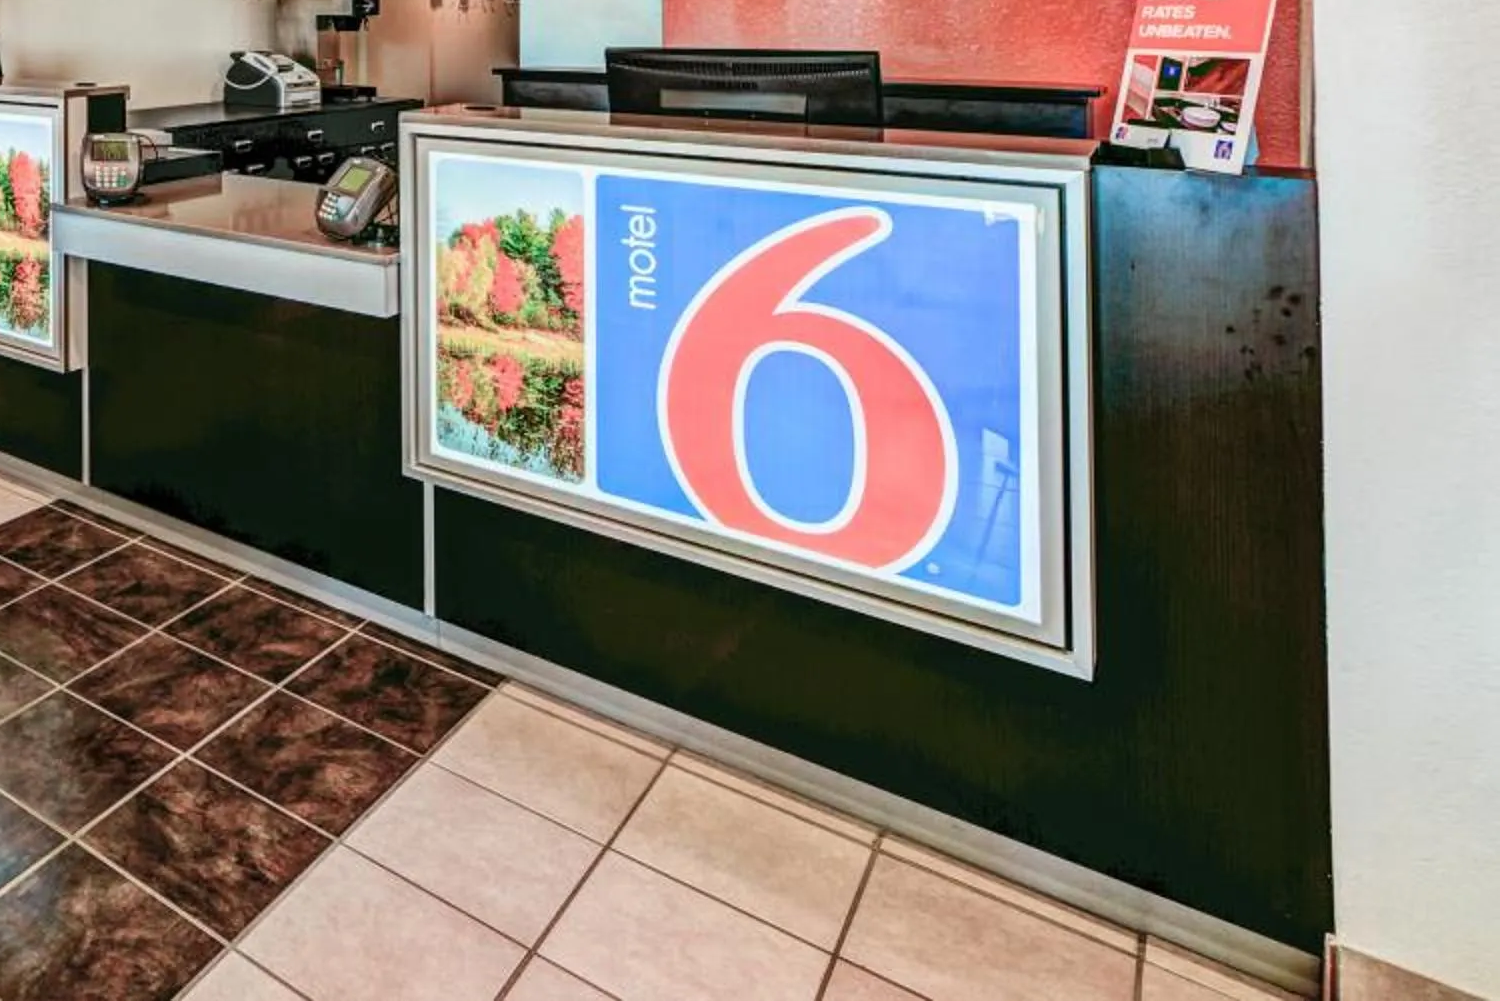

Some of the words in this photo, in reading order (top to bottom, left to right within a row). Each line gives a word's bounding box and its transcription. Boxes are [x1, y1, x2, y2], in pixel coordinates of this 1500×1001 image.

[1141, 5, 1197, 20] RATES
[619, 204, 657, 310] motel
[657, 206, 958, 575] 6
